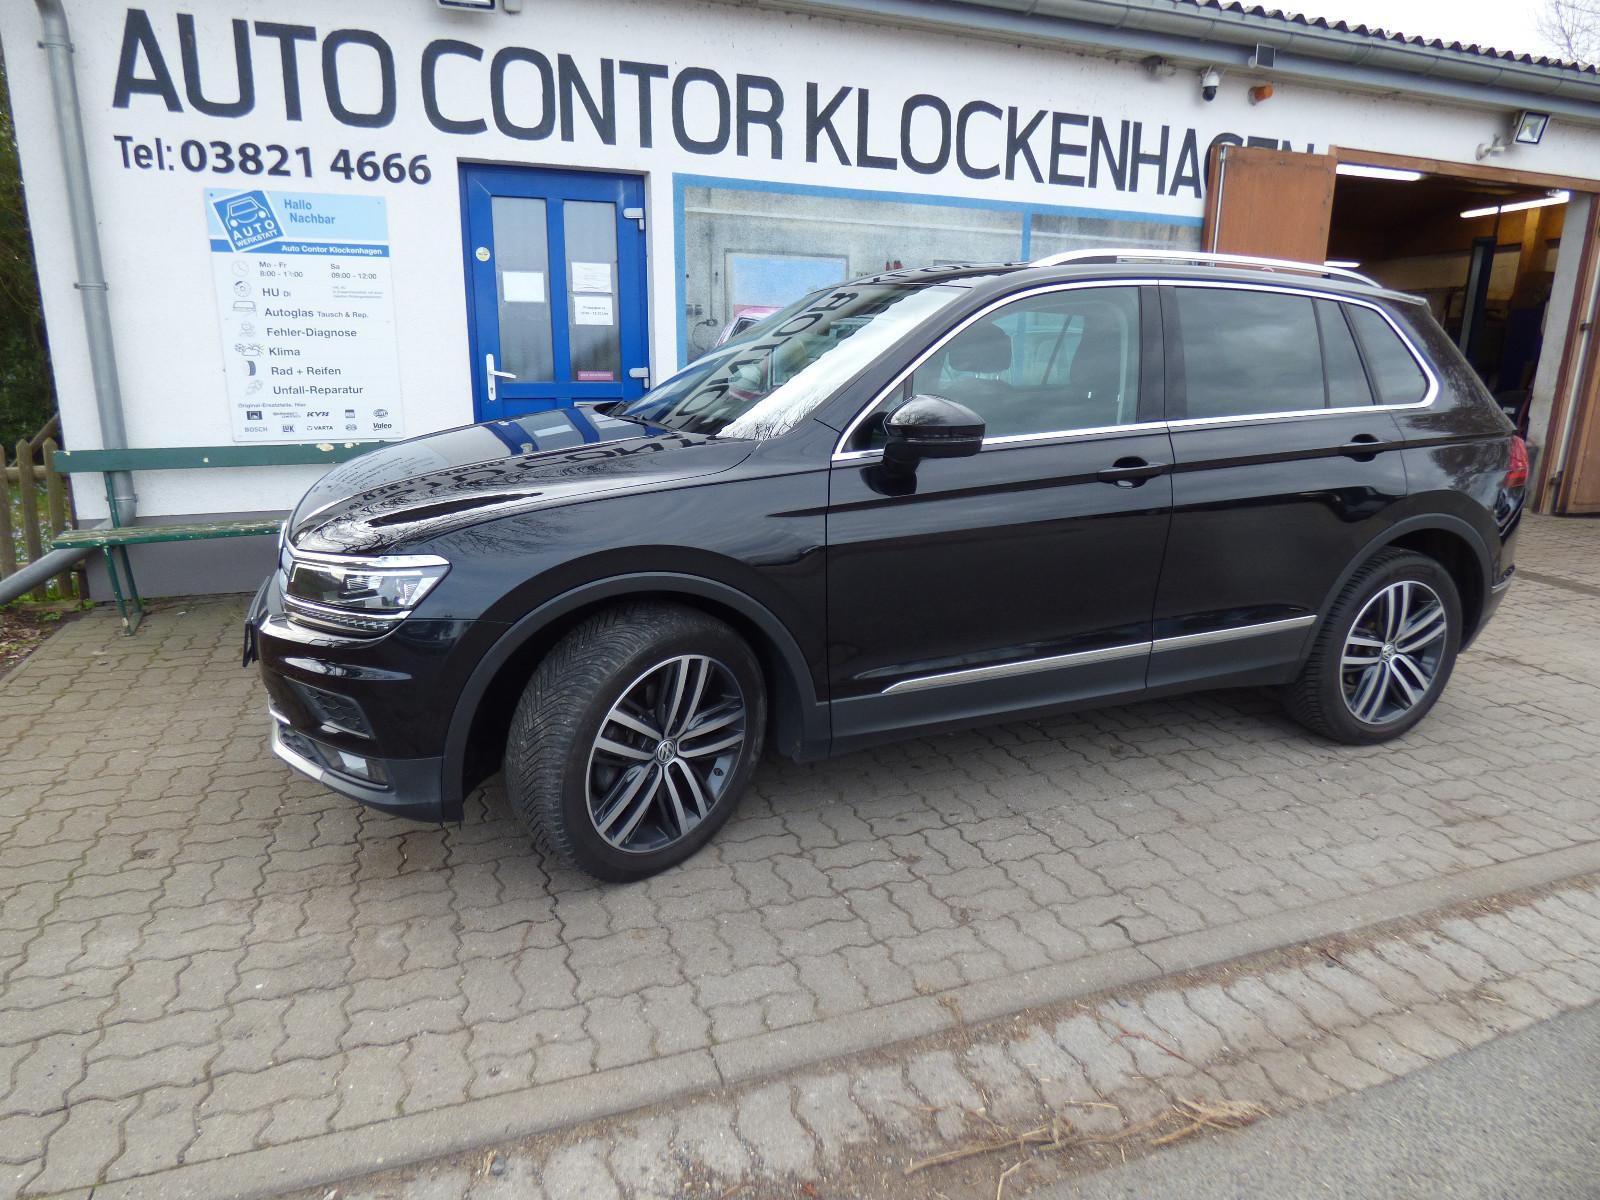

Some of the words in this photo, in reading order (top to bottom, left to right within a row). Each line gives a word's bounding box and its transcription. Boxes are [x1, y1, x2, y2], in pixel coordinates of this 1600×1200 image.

[112, 8, 397, 129] AUTO
[420, 37, 785, 161] CONTOR
[805, 81, 1315, 199] KLOCKENHA
[114, 135, 174, 171] Tel:
[180, 139, 314, 179] 03821
[329, 148, 432, 185] 4666
[284, 198, 312, 210] Hallo
[289, 212, 336, 225] Nachbar
[232, 221, 276, 240] AUTO
[235, 230, 279, 247] WERKSTATT
[281, 244, 300, 253] Auto
[301, 245, 328, 254] Contor
[329, 246, 383, 256] Klockenhagen
[262, 287, 280, 297] HU
[264, 308, 314, 319] Autoglas
[352, 311, 369, 320] Rep.
[266, 327, 357, 339] Fehler-Diagnose
[268, 347, 301, 356] Klima
[271, 366, 293, 376] Rad
[306, 366, 341, 376] Reifen
[273, 385, 364, 397] Unfall-Reparatur
